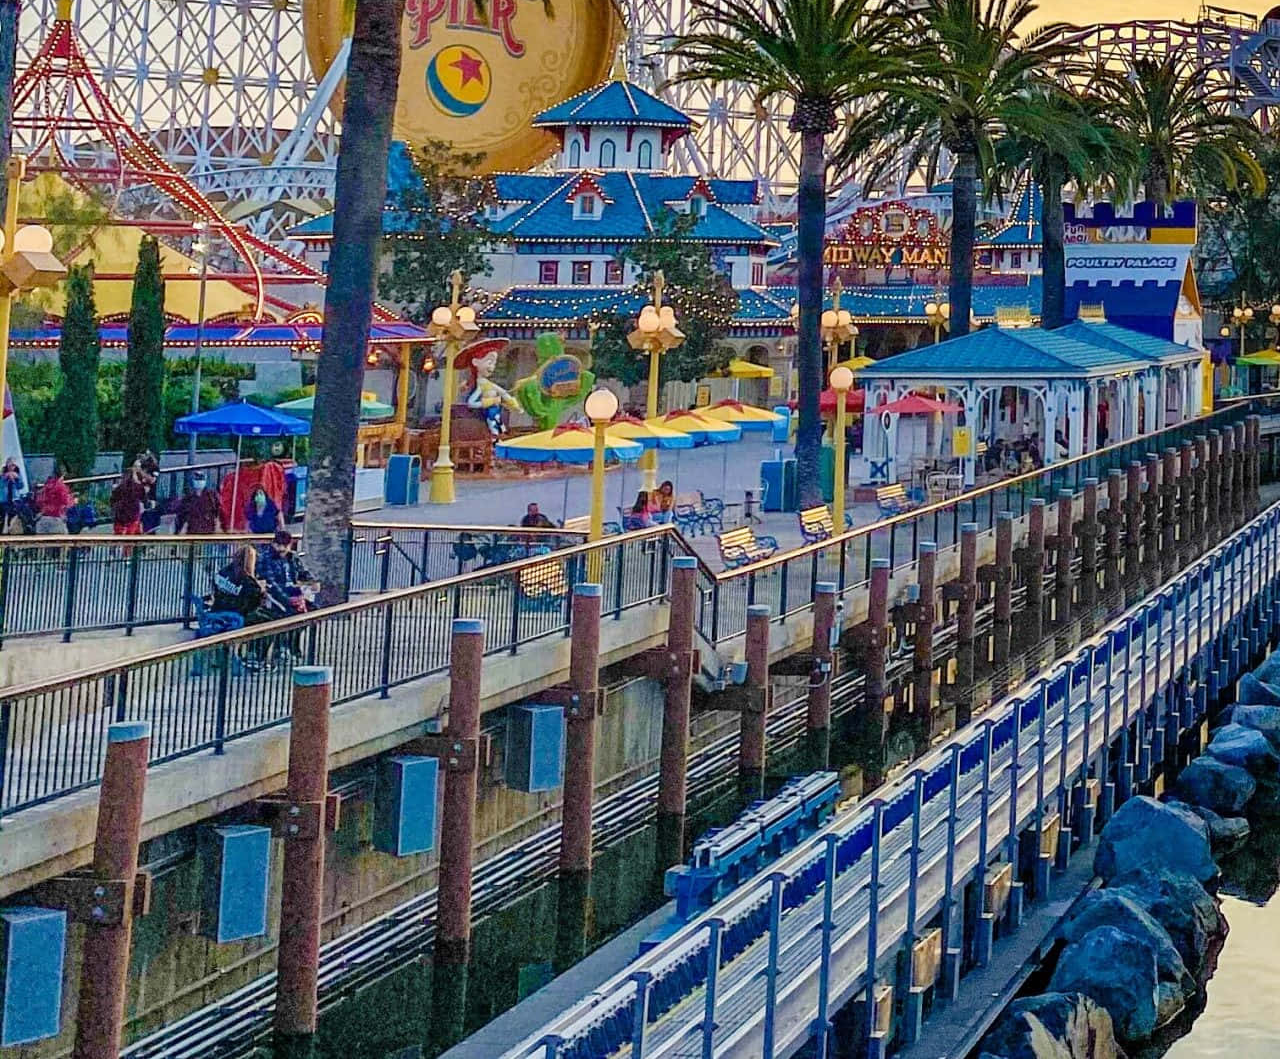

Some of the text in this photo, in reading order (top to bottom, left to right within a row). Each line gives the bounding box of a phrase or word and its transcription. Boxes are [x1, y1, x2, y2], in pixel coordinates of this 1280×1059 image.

[901, 247, 948, 264] MAN
[1067, 257, 1176, 269] POULTRY PALACE
